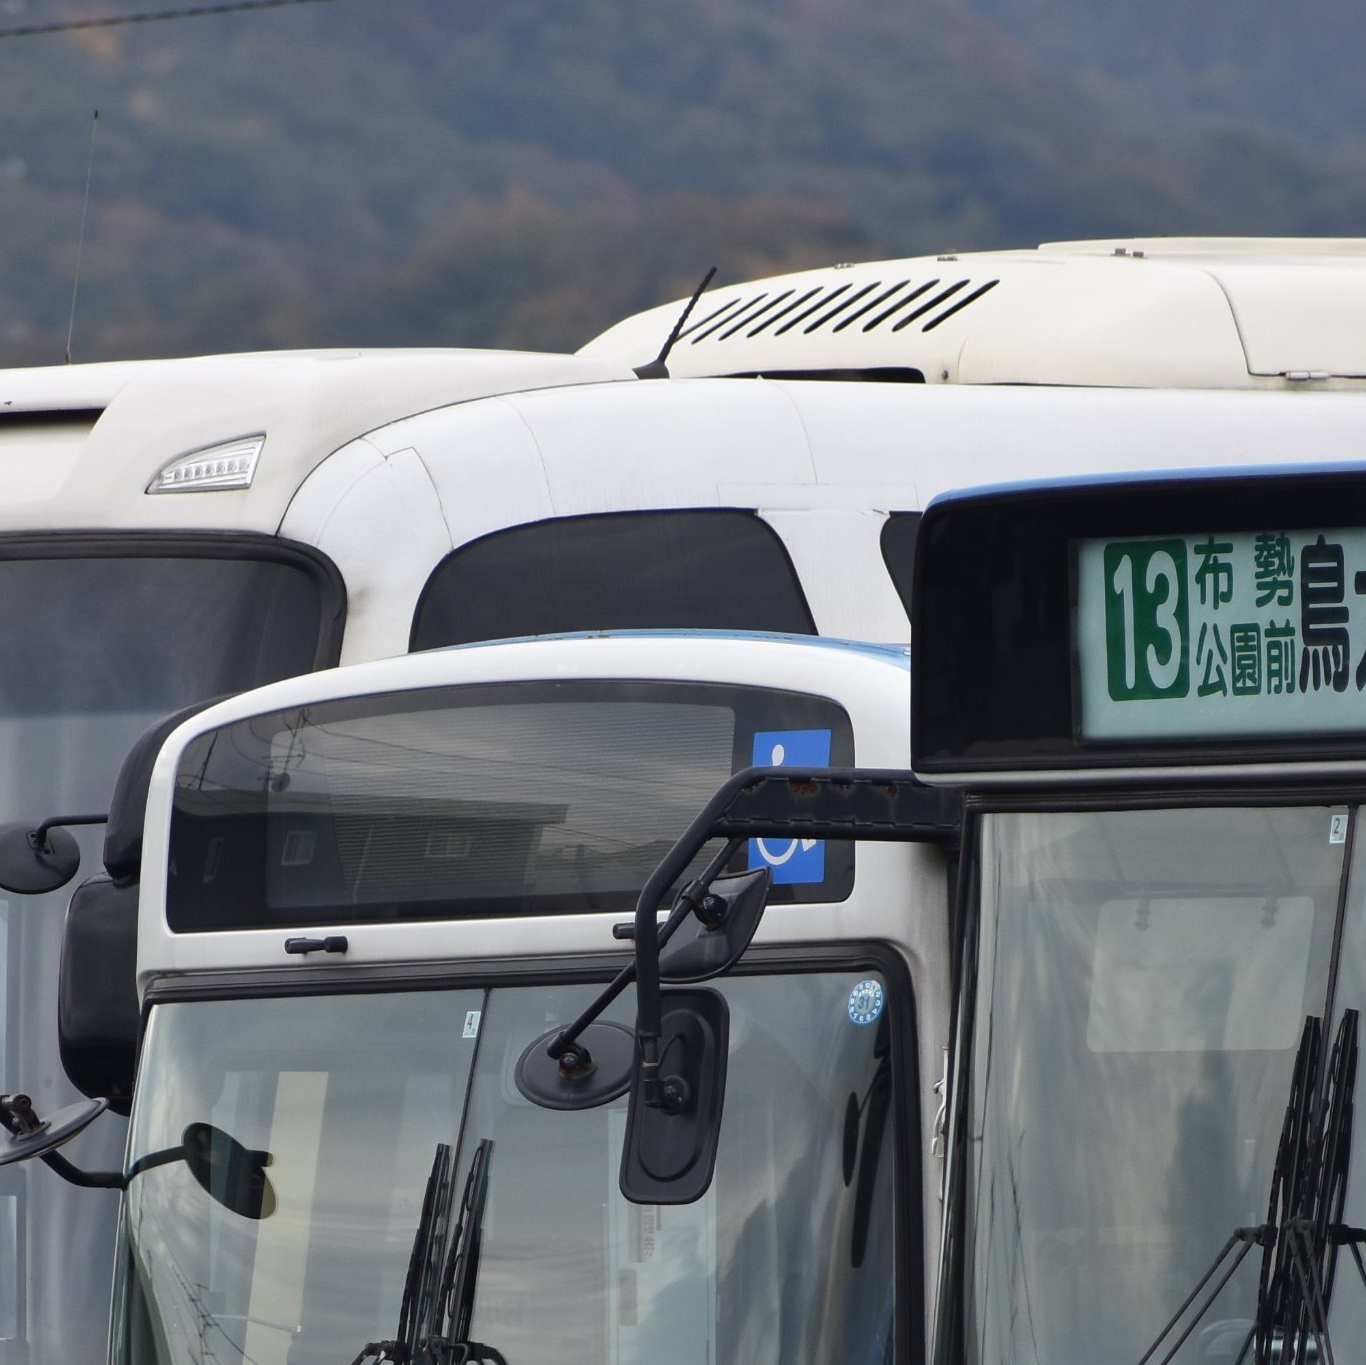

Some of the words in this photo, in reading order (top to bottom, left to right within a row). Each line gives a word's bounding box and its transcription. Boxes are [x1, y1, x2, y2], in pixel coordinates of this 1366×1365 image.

[1194, 533, 1295, 610] 布勢
[1113, 550, 1182, 690] 13
[1195, 618, 1296, 698] 公園前
[1333, 817, 1341, 834] 2
